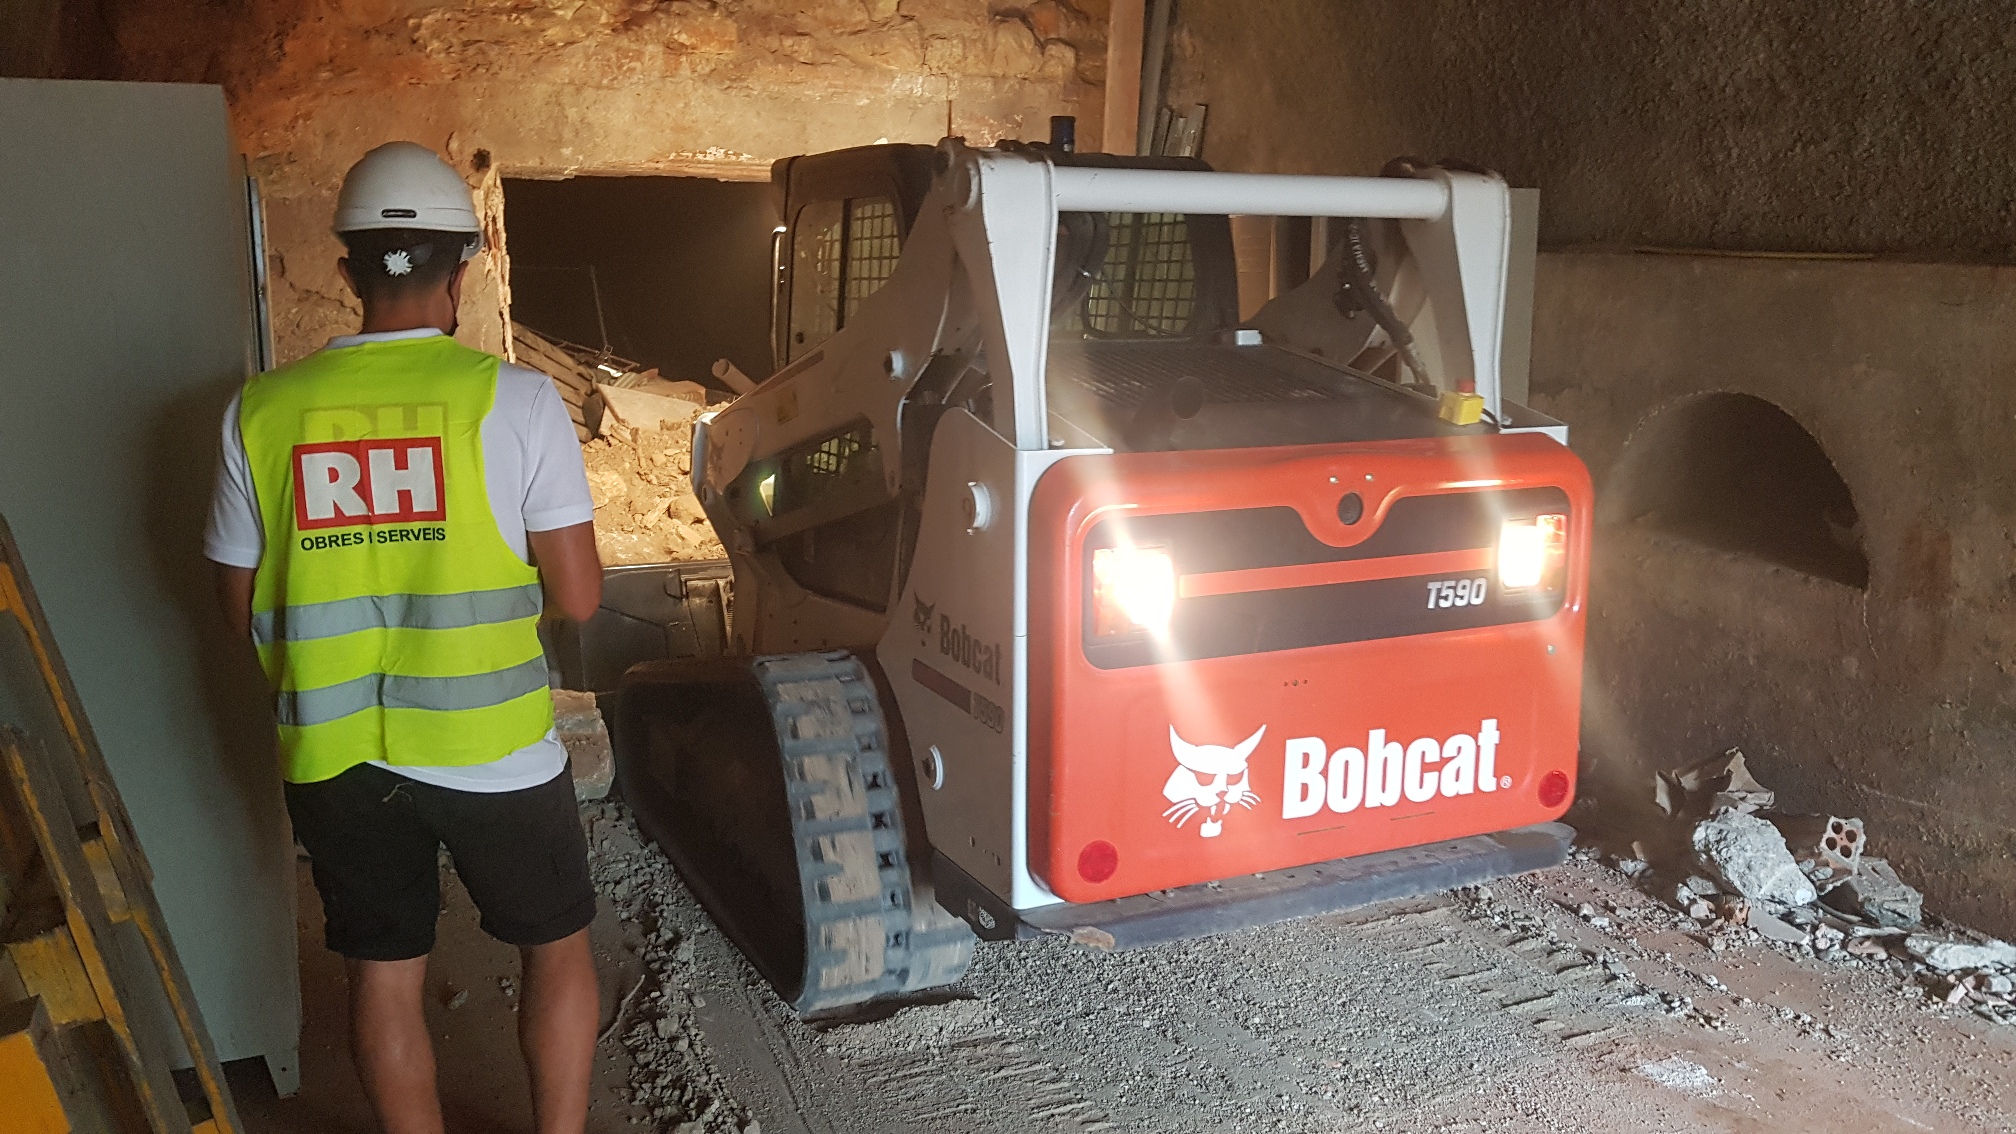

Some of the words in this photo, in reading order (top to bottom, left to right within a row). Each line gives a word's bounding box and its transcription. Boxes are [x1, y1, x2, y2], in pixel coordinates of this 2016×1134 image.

[300, 446, 438, 521] RH
[300, 531, 365, 551] OBRES
[368, 531, 373, 544] I
[376, 527, 446, 544] SERVEIS
[1426, 577, 1488, 609] T590
[939, 612, 1001, 686] Bobcat
[1281, 718, 1500, 820] Bobcat
